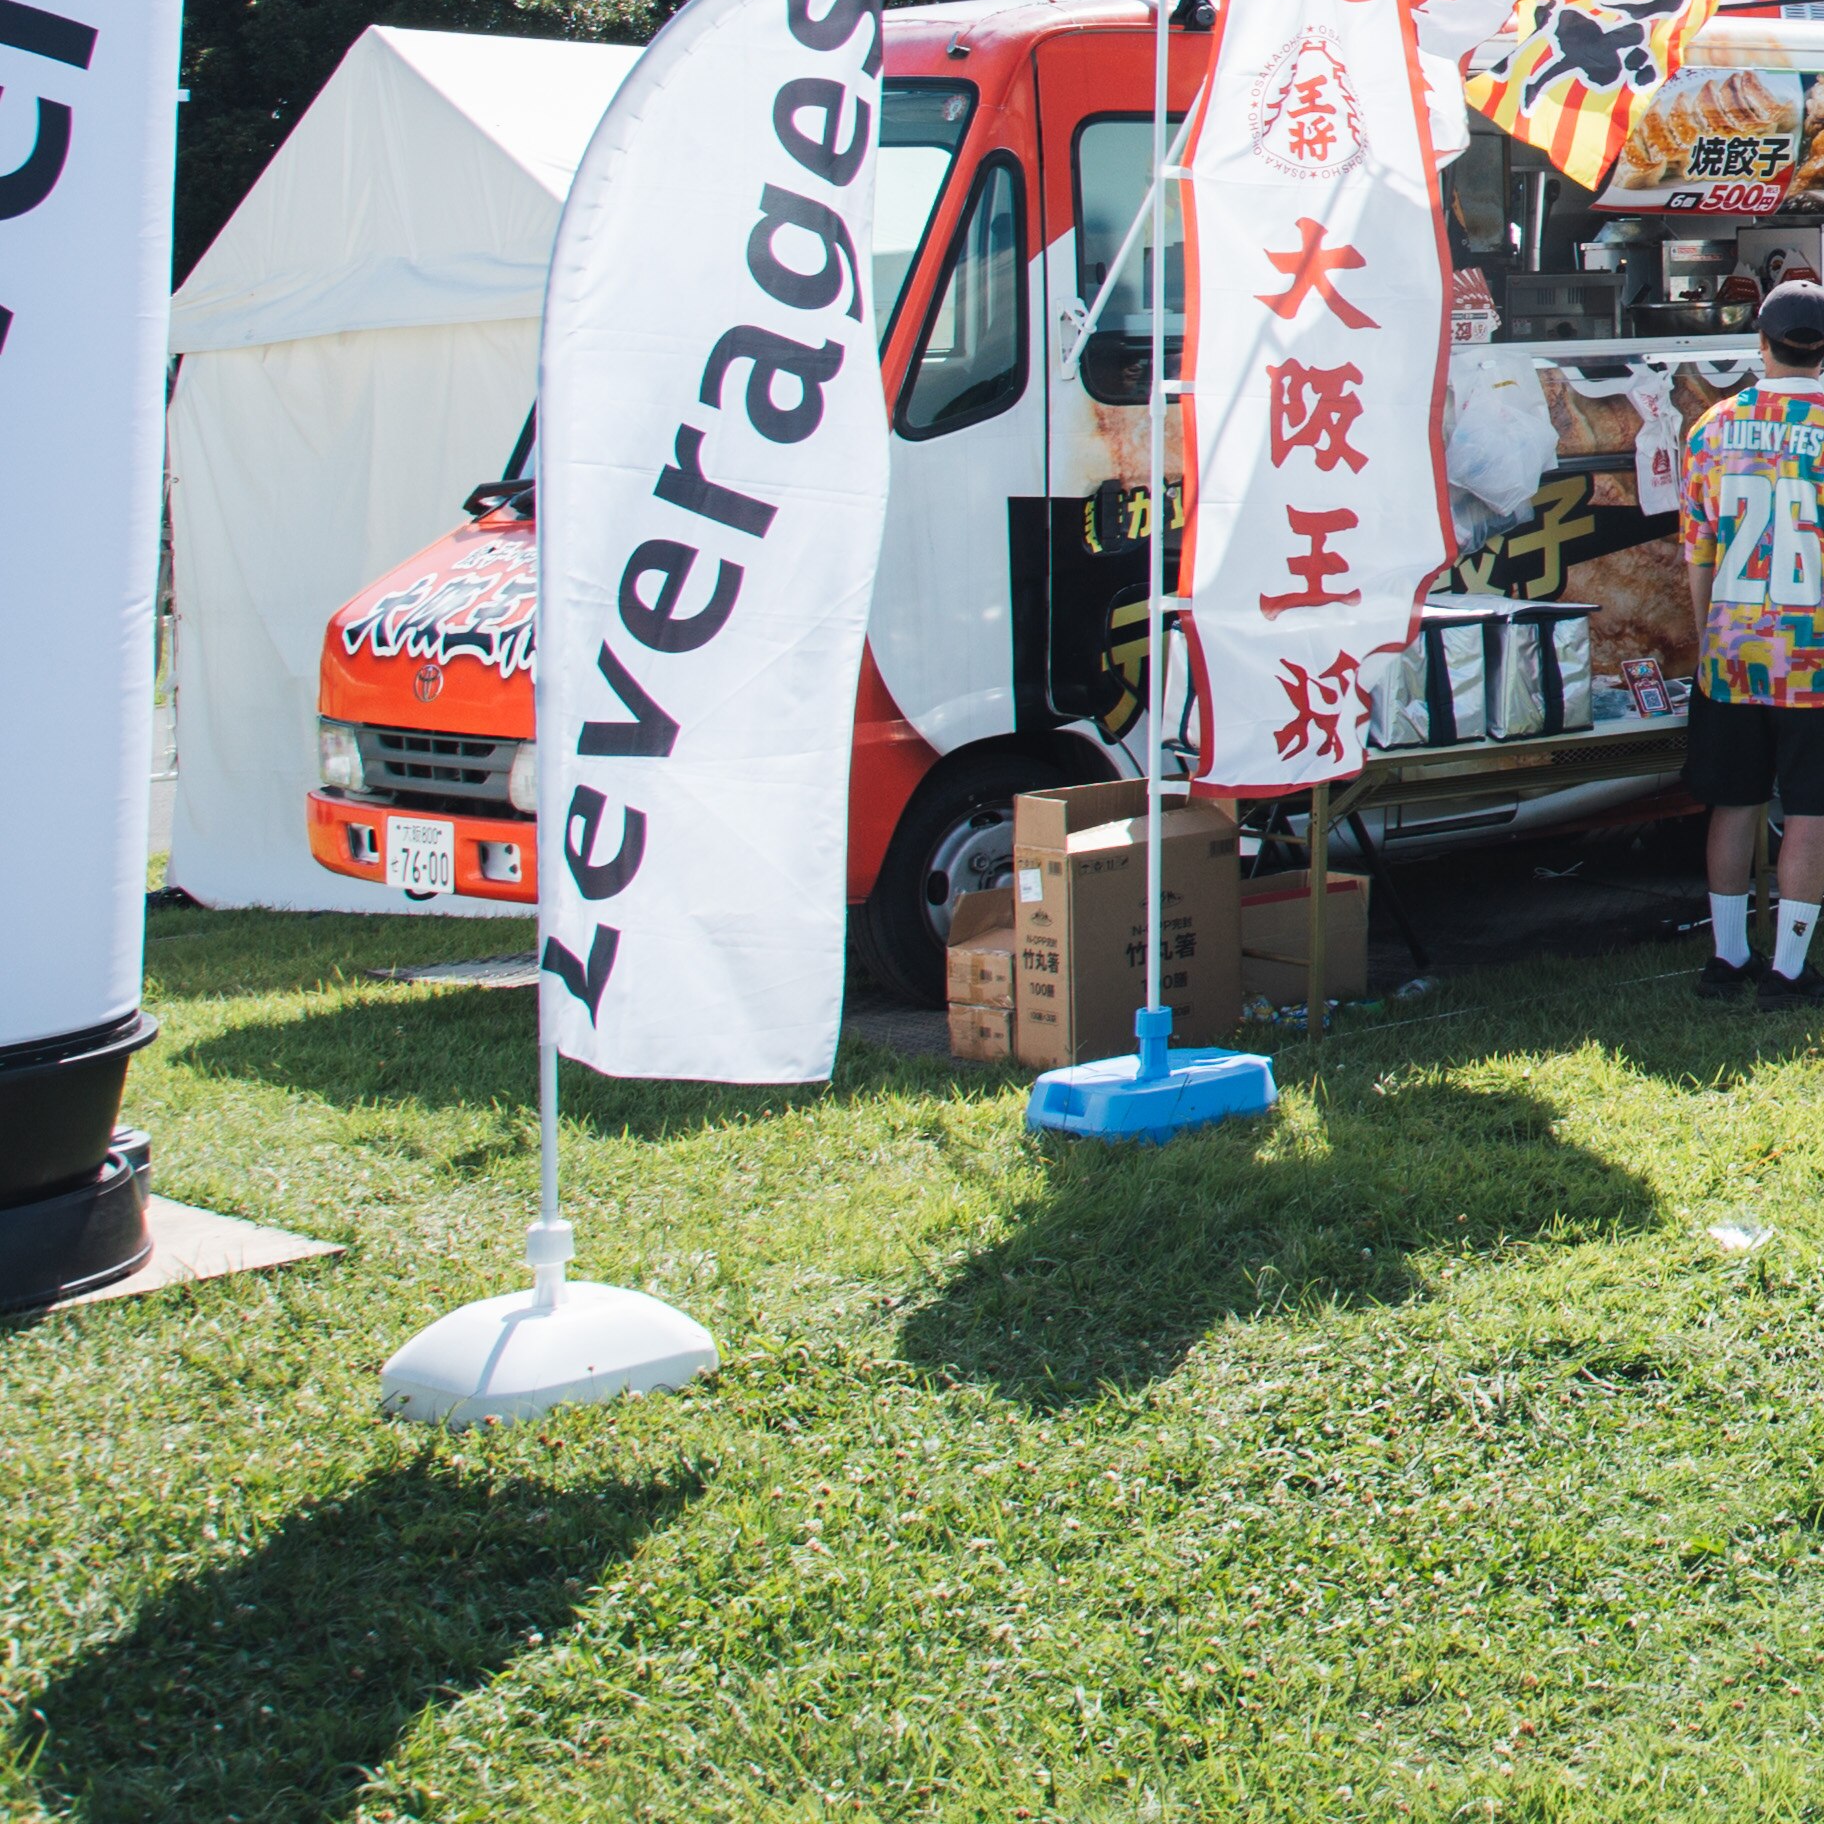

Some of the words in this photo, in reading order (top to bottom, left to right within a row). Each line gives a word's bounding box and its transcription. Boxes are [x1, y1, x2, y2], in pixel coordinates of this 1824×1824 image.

[1287, 75, 1337, 161] 王将
[1687, 136, 1791, 177] 焼餃子
[1723, 420, 1788, 452] LUCKY
[1789, 424, 1824, 458] FES
[1254, 216, 1382, 766] 大阪王将
[1711, 474, 1823, 607] 26
[1022, 947, 1060, 975] 竹丸箸
